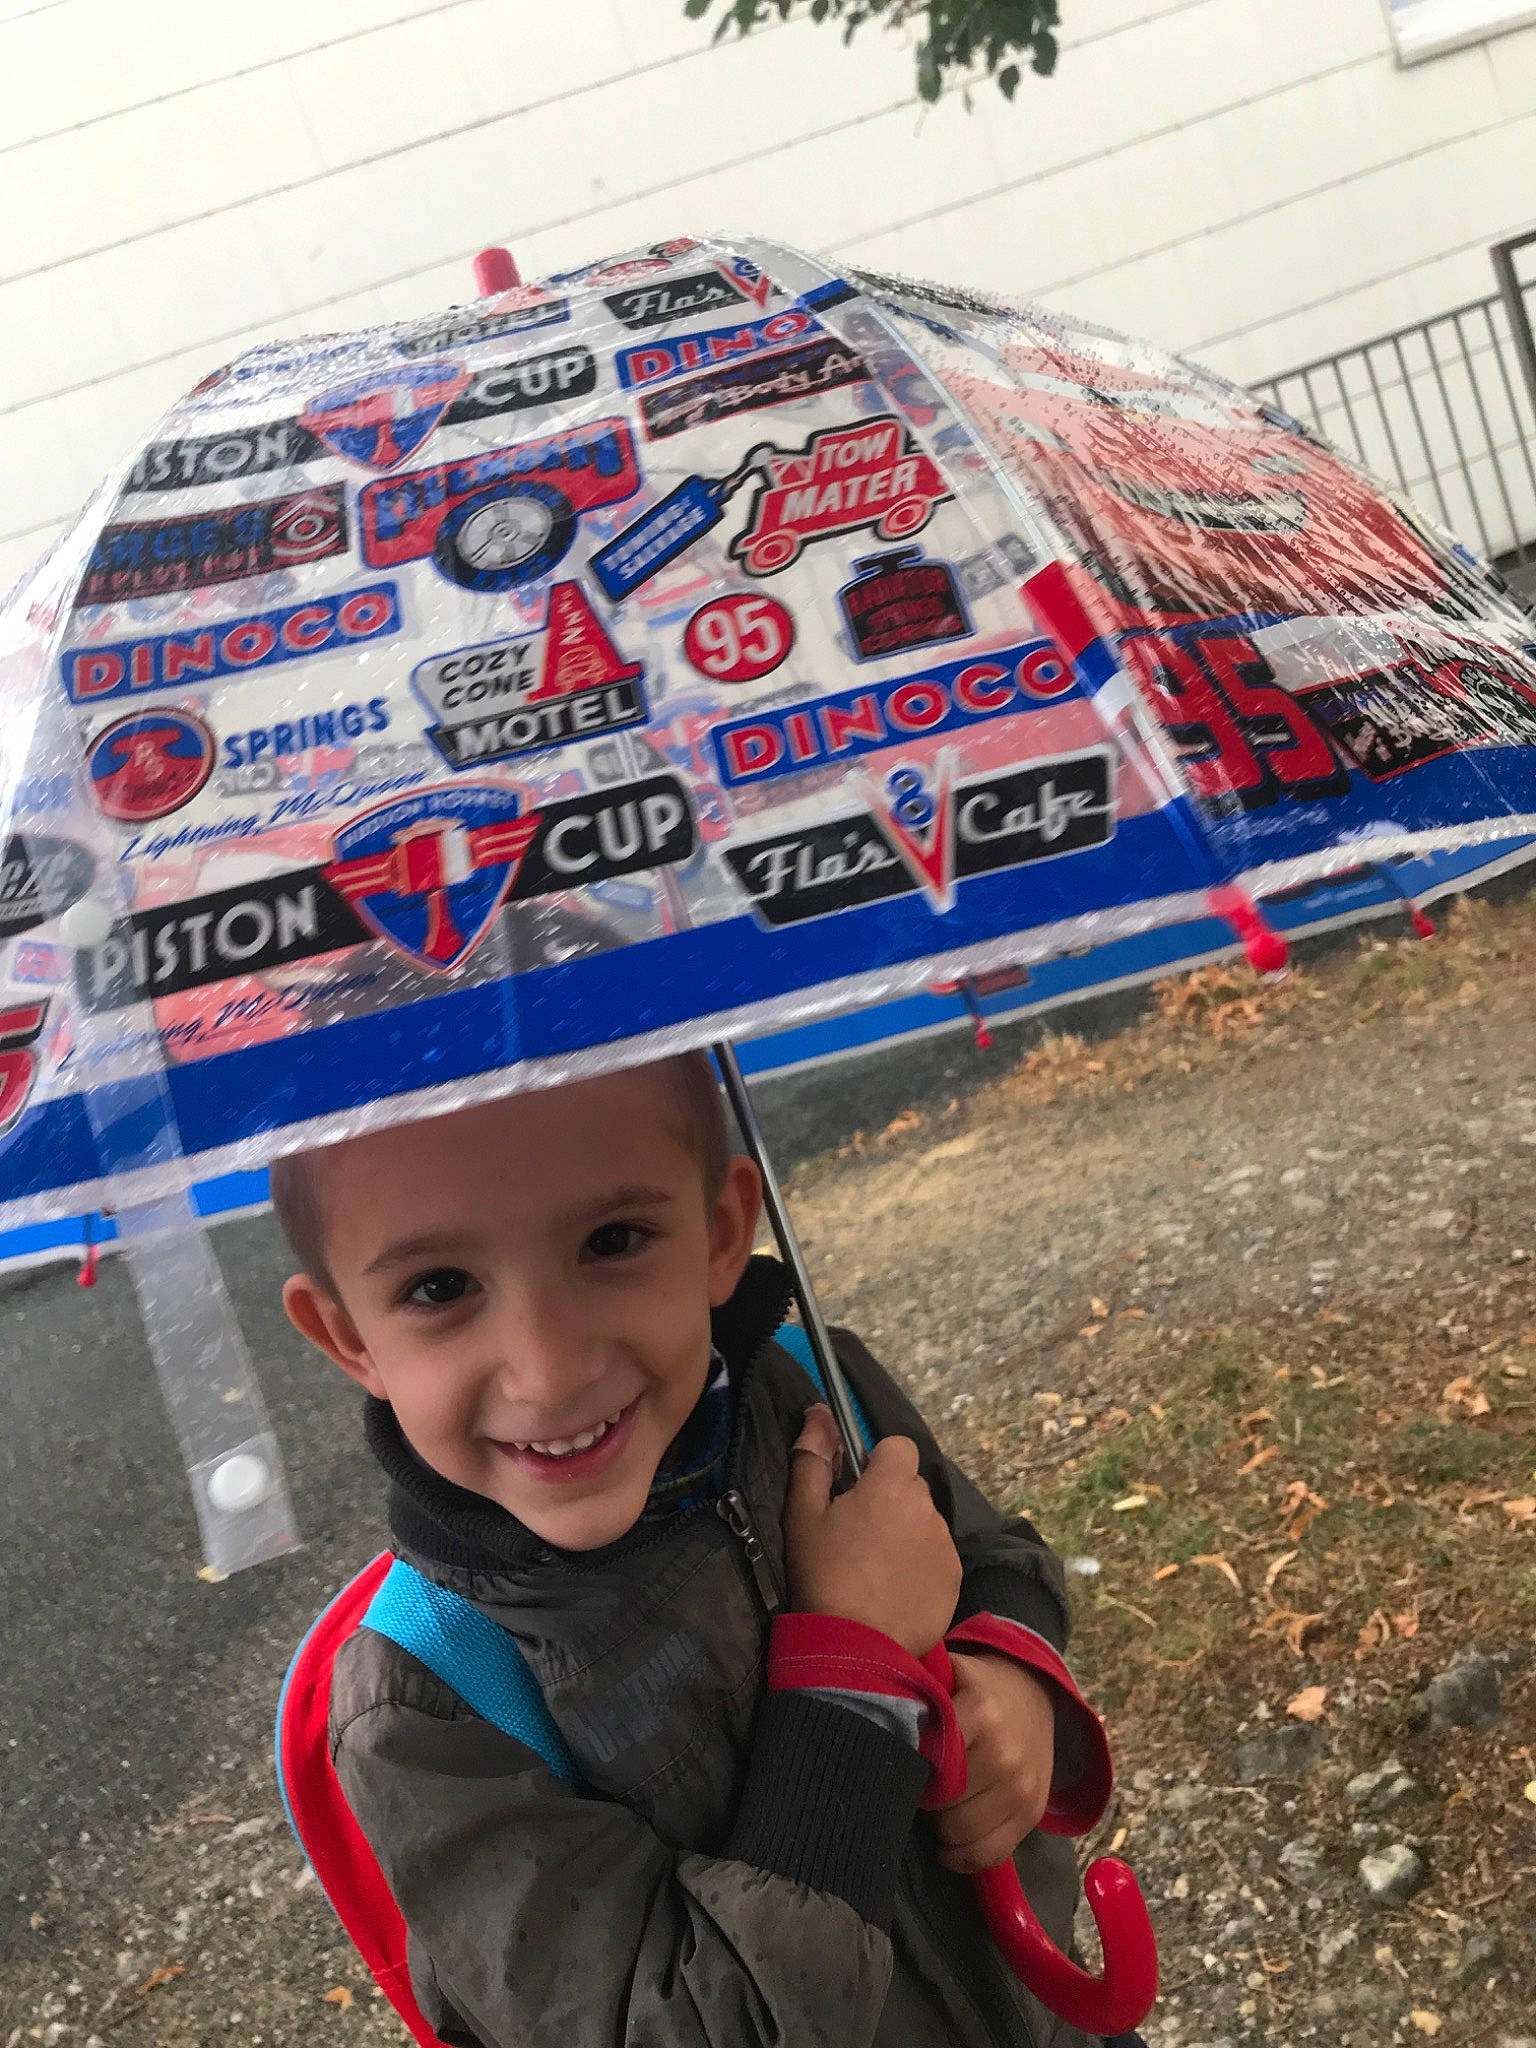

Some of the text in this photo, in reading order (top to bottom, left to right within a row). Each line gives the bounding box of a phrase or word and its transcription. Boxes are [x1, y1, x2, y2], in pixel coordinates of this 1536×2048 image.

[474, 354, 588, 405] CUP
[627, 313, 809, 384] DINO
[815, 428, 895, 474] TOW
[779, 458, 920, 526] MATER
[73, 591, 394, 697] DINOCO
[438, 642, 531, 684] COZY
[699, 600, 776, 676] 95
[441, 667, 536, 711] CONE
[455, 687, 640, 758] MOTEL
[724, 644, 1078, 780] DINOCO
[1118, 632, 1338, 798] 95
[222, 697, 391, 770] SPRINGS
[118, 813, 265, 863] Lightning
[96, 884, 320, 986] PISTON
[542, 792, 686, 875] CUP
